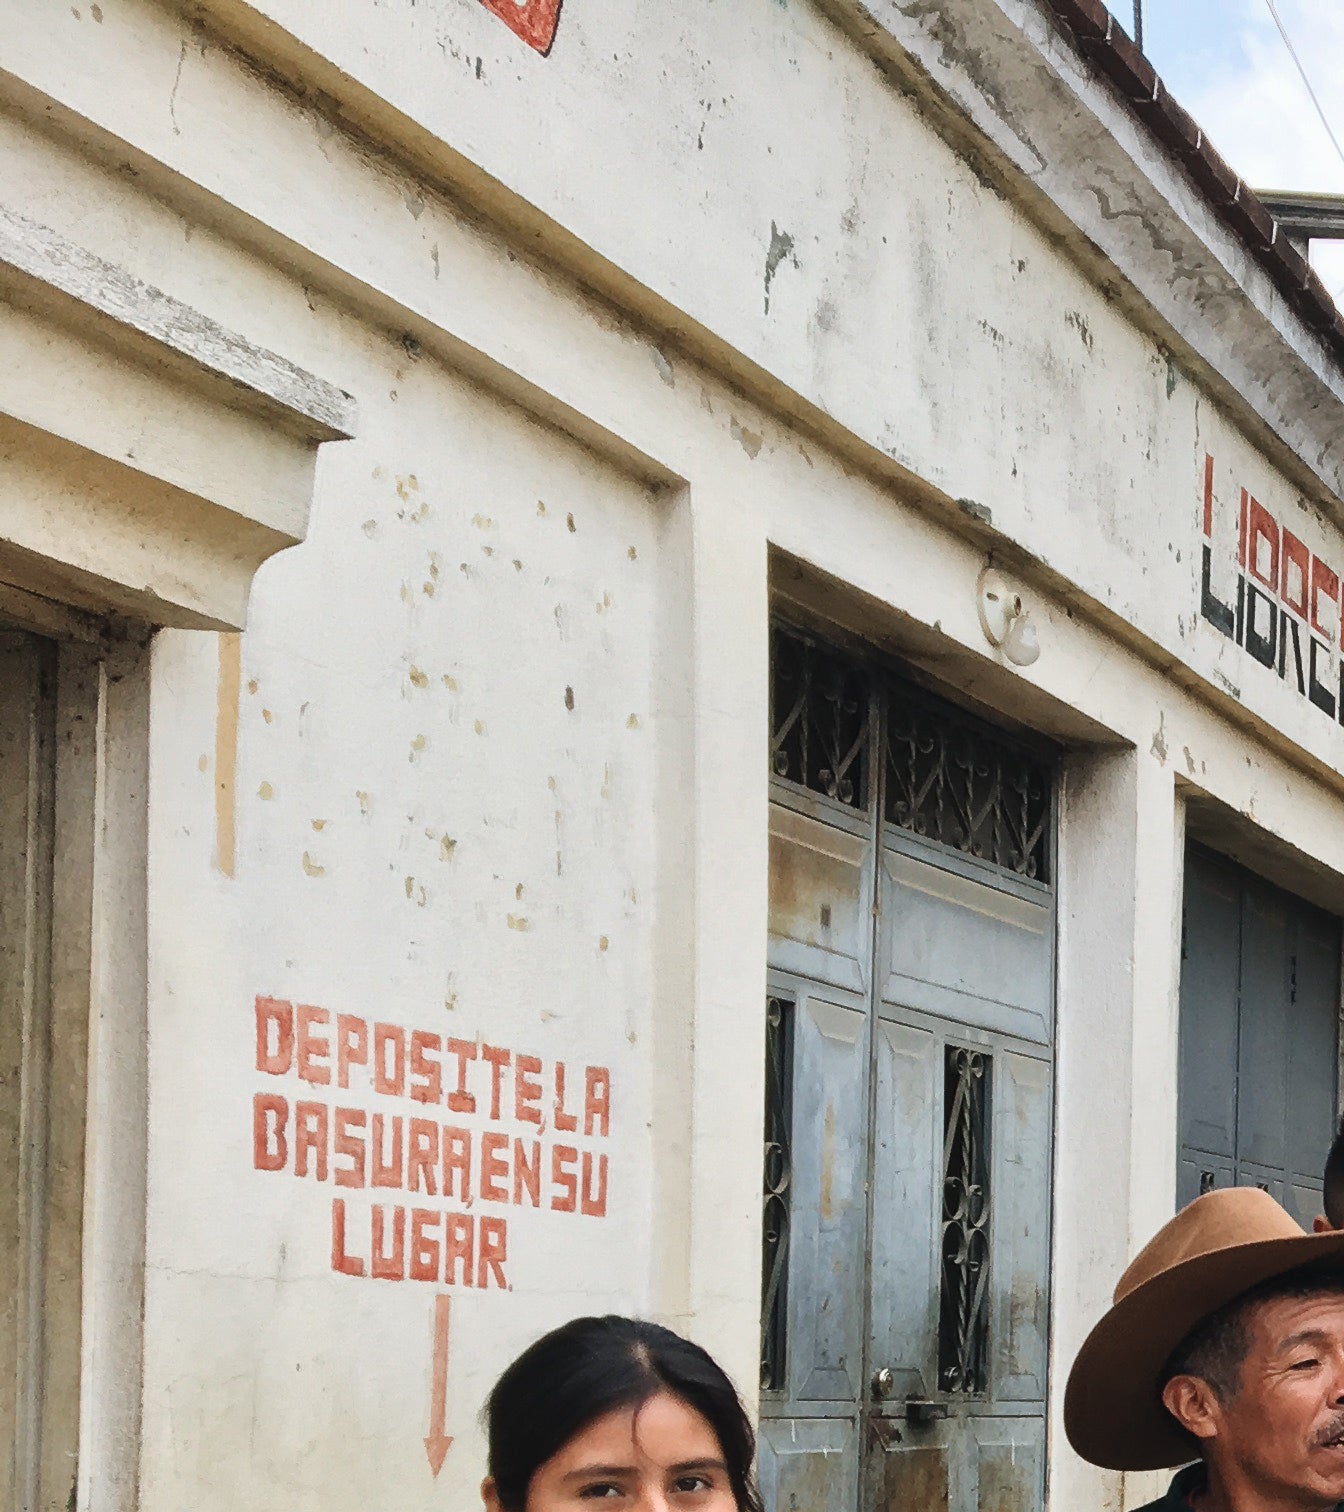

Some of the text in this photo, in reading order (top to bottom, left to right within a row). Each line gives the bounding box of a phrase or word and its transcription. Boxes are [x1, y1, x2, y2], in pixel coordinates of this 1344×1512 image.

[554, 1061, 611, 1137] LA
[480, 1131, 542, 1208] EN
[550, 1143, 609, 1218] SU
